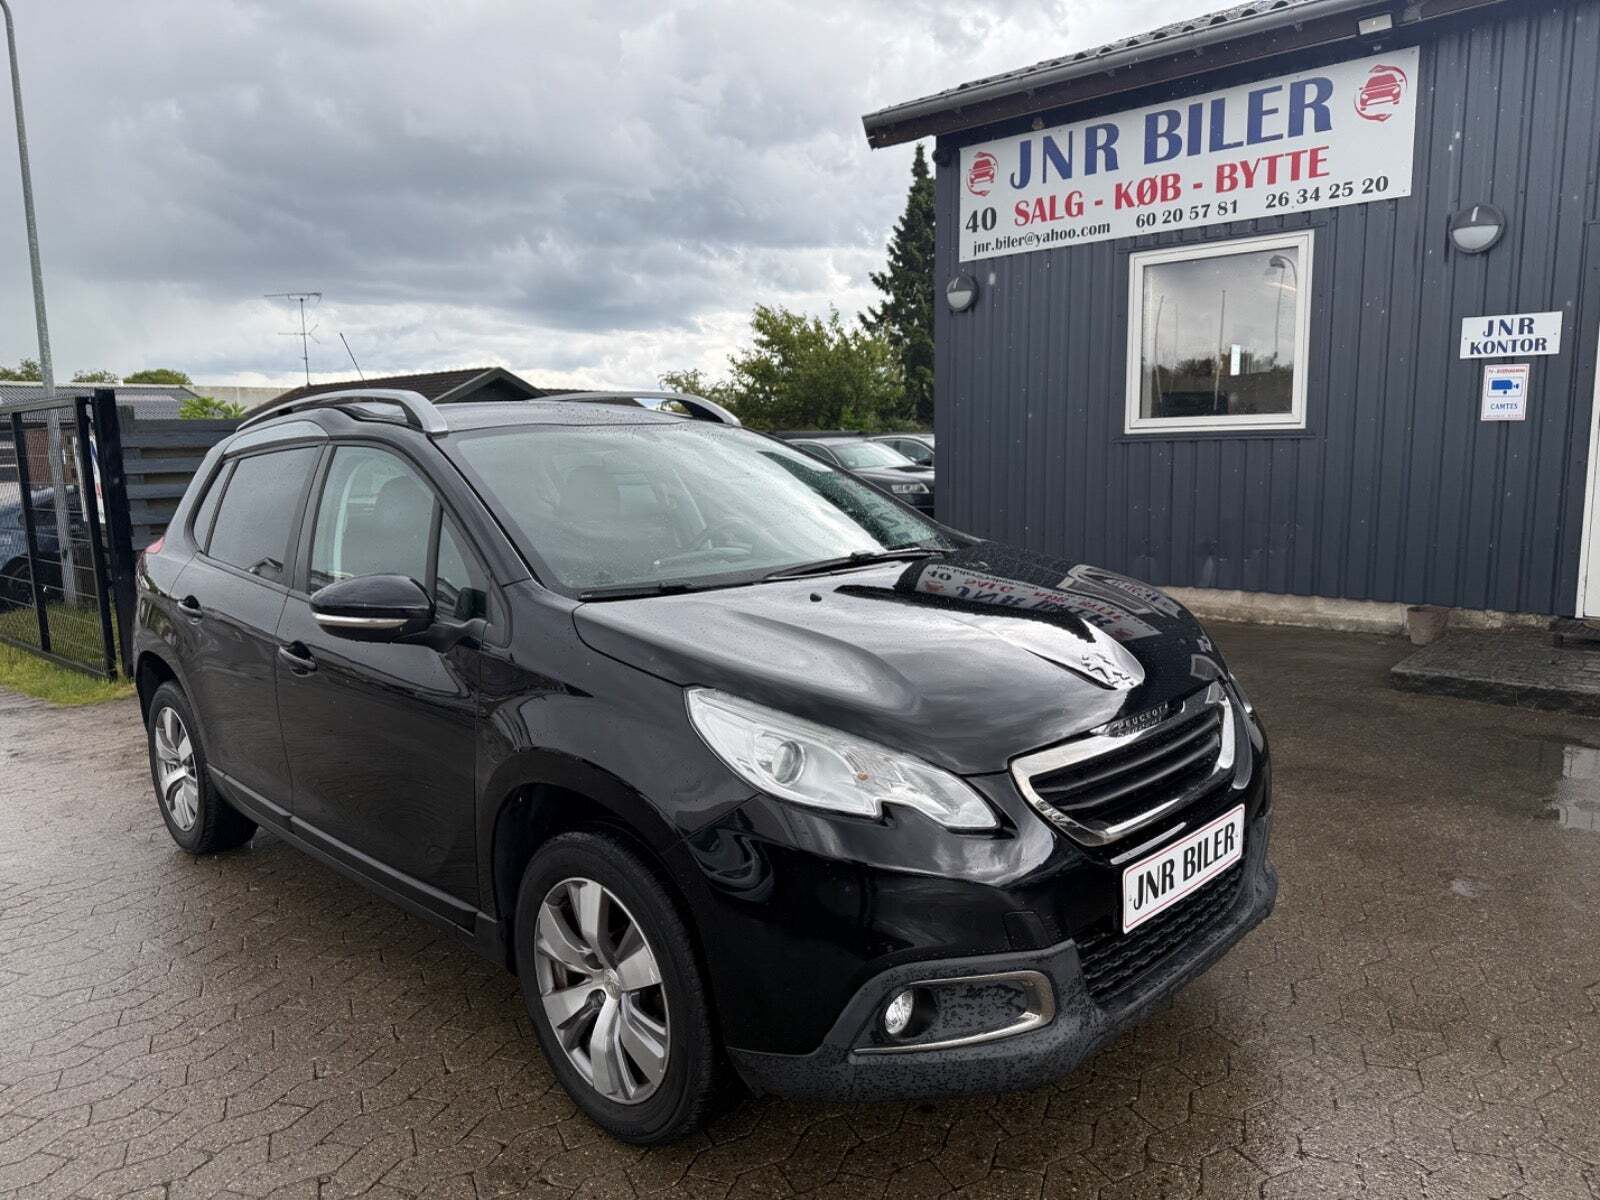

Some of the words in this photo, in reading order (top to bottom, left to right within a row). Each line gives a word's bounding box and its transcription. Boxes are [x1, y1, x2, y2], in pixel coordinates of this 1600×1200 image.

[1009, 122, 1119, 189] JNR
[1143, 76, 1334, 165] BILER
[1014, 190, 1084, 227] SALG
[1114, 174, 1182, 210] KØB
[1215, 145, 1330, 194] BYTTE
[1265, 191, 1289, 209] 26
[1296, 186, 1320, 204] 34
[1328, 181, 1354, 200] 25
[1361, 175, 1389, 194] 20
[965, 206, 997, 233] 40
[1135, 212, 1156, 228] 60
[1161, 208, 1184, 224] 20
[1189, 203, 1211, 221] 57
[1216, 199, 1238, 216] 81
[973, 222, 1111, 256] jnr.biler@yahoo.com
[1482, 316, 1535, 338] JNR
[1469, 337, 1548, 355] KONTOR
[1133, 858, 1175, 911] JNR
[1182, 822, 1236, 883] BILER
